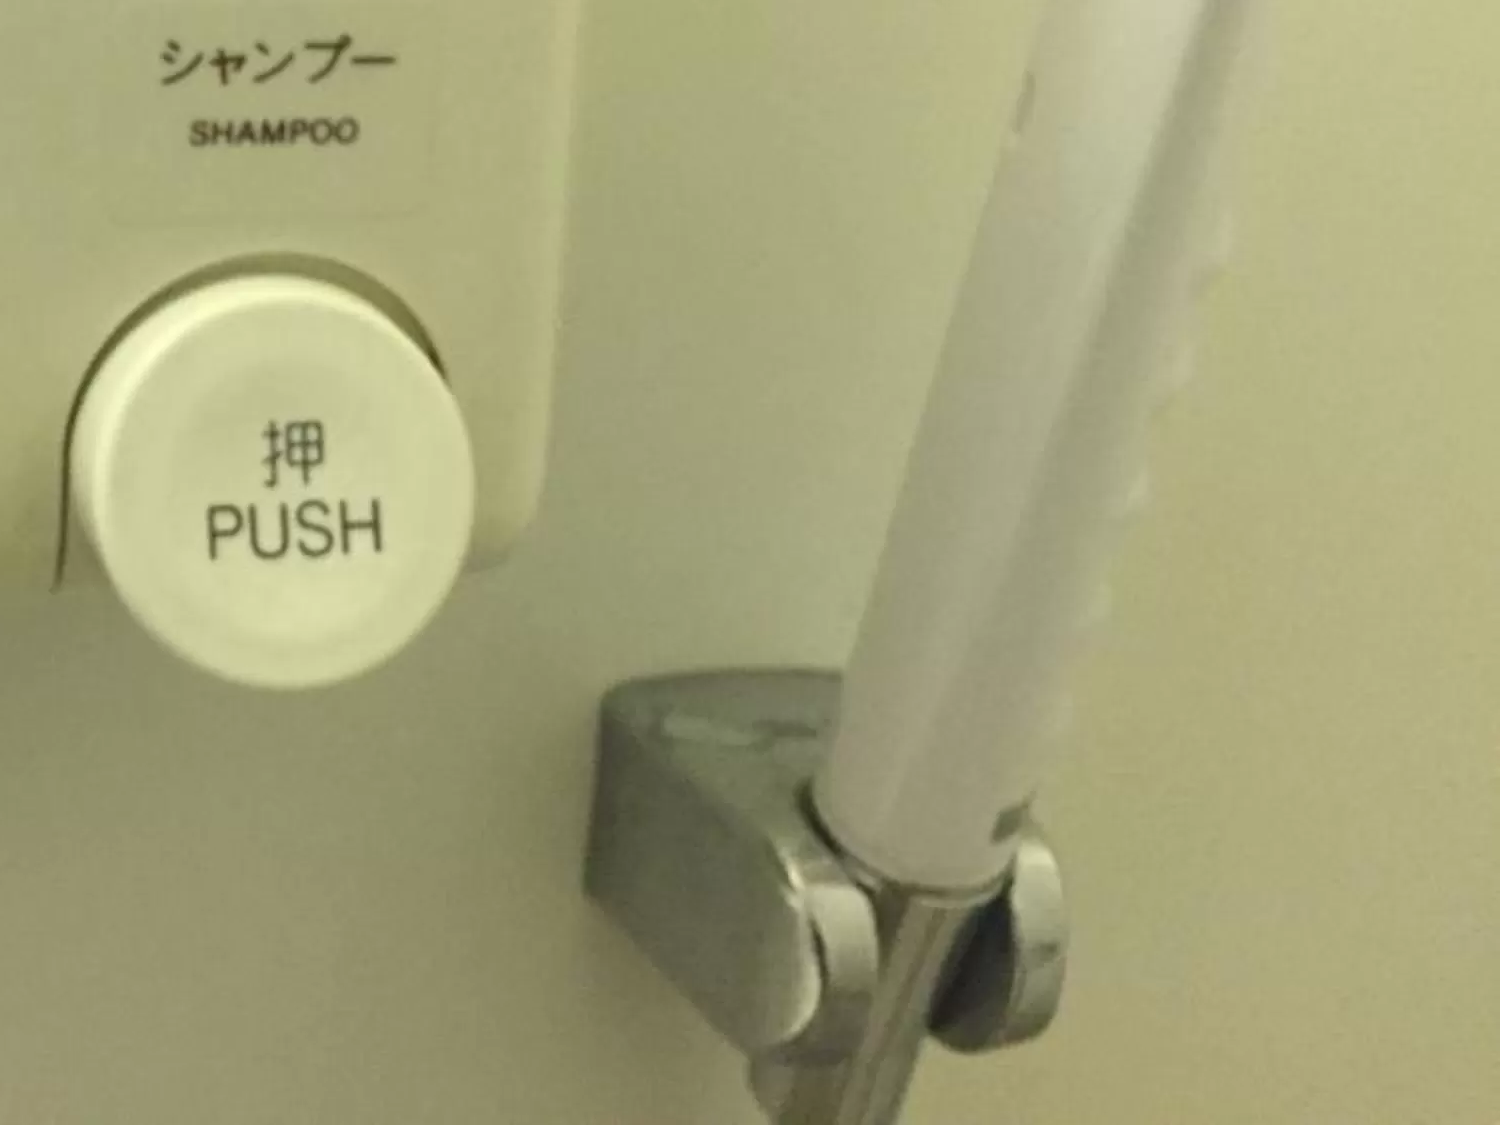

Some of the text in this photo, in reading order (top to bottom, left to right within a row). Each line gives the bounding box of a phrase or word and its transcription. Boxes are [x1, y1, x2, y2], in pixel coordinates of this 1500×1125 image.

[159, 32, 397, 87] シャンプー
[188, 115, 361, 148] SHAMPOO
[262, 419, 326, 489] 押
[205, 499, 384, 560] PUSH
